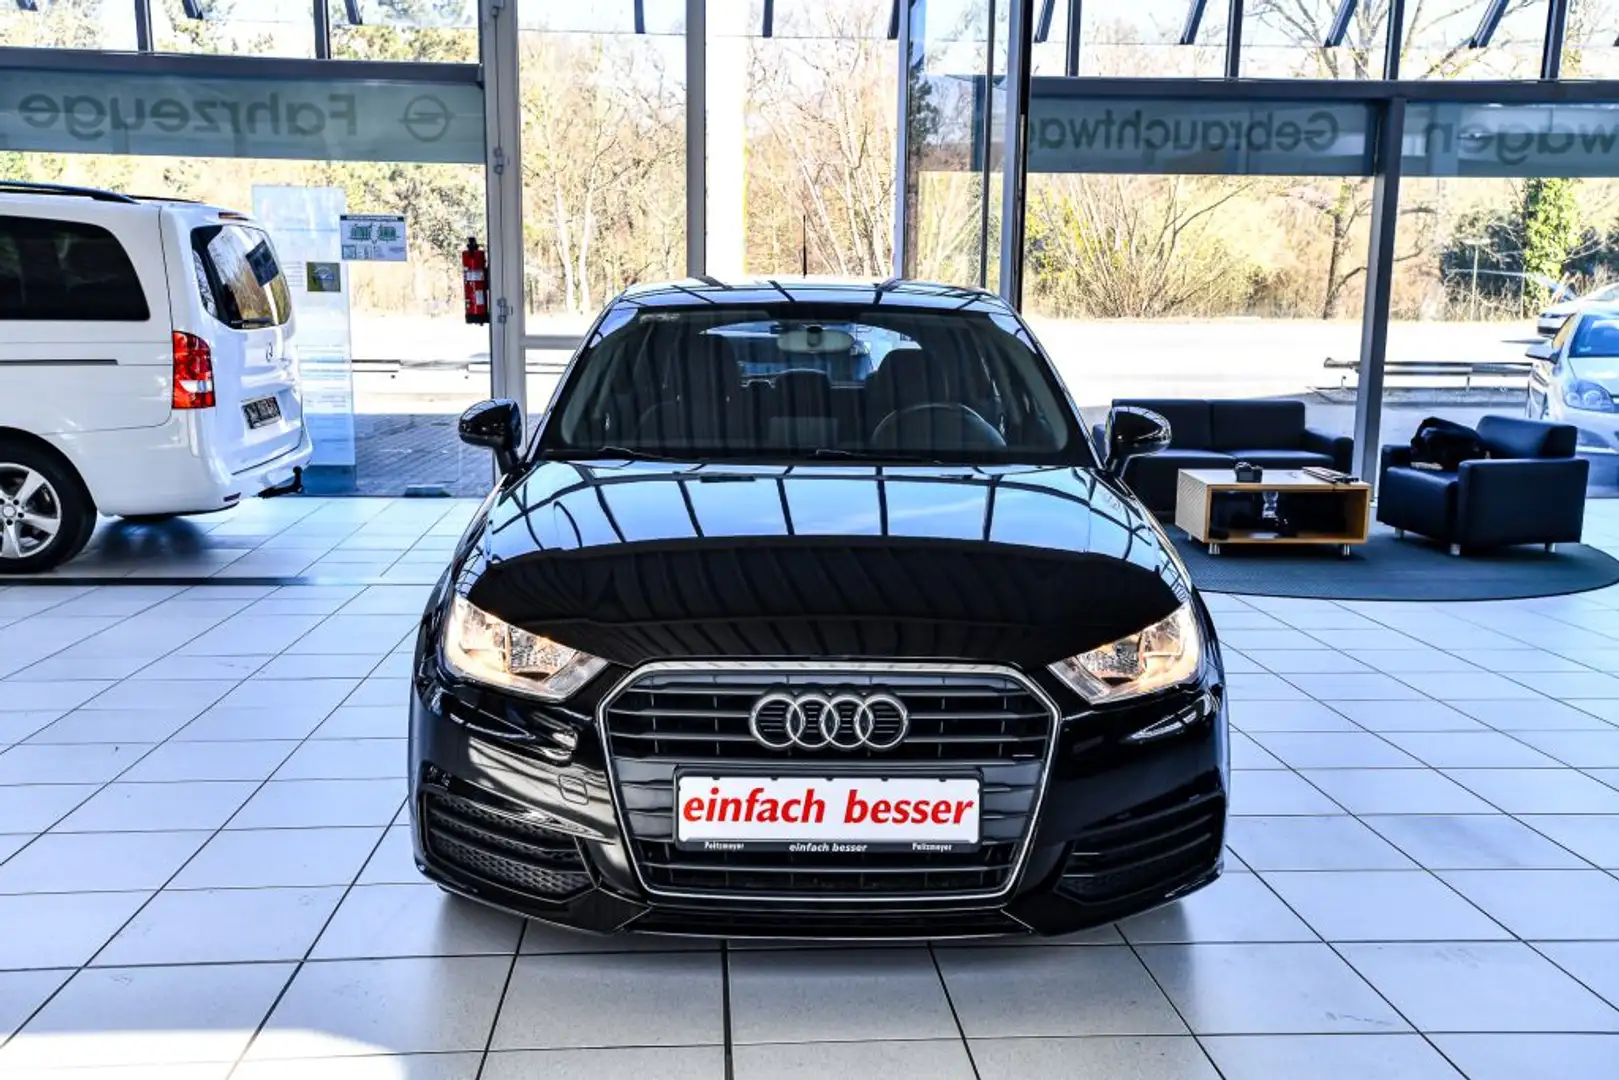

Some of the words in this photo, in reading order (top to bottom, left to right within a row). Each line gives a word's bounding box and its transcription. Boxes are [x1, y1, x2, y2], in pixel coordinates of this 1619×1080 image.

[683, 787, 826, 824] einfach
[844, 789, 975, 825] besser
[788, 842, 830, 853] einfach
[831, 842, 868, 853] besser
